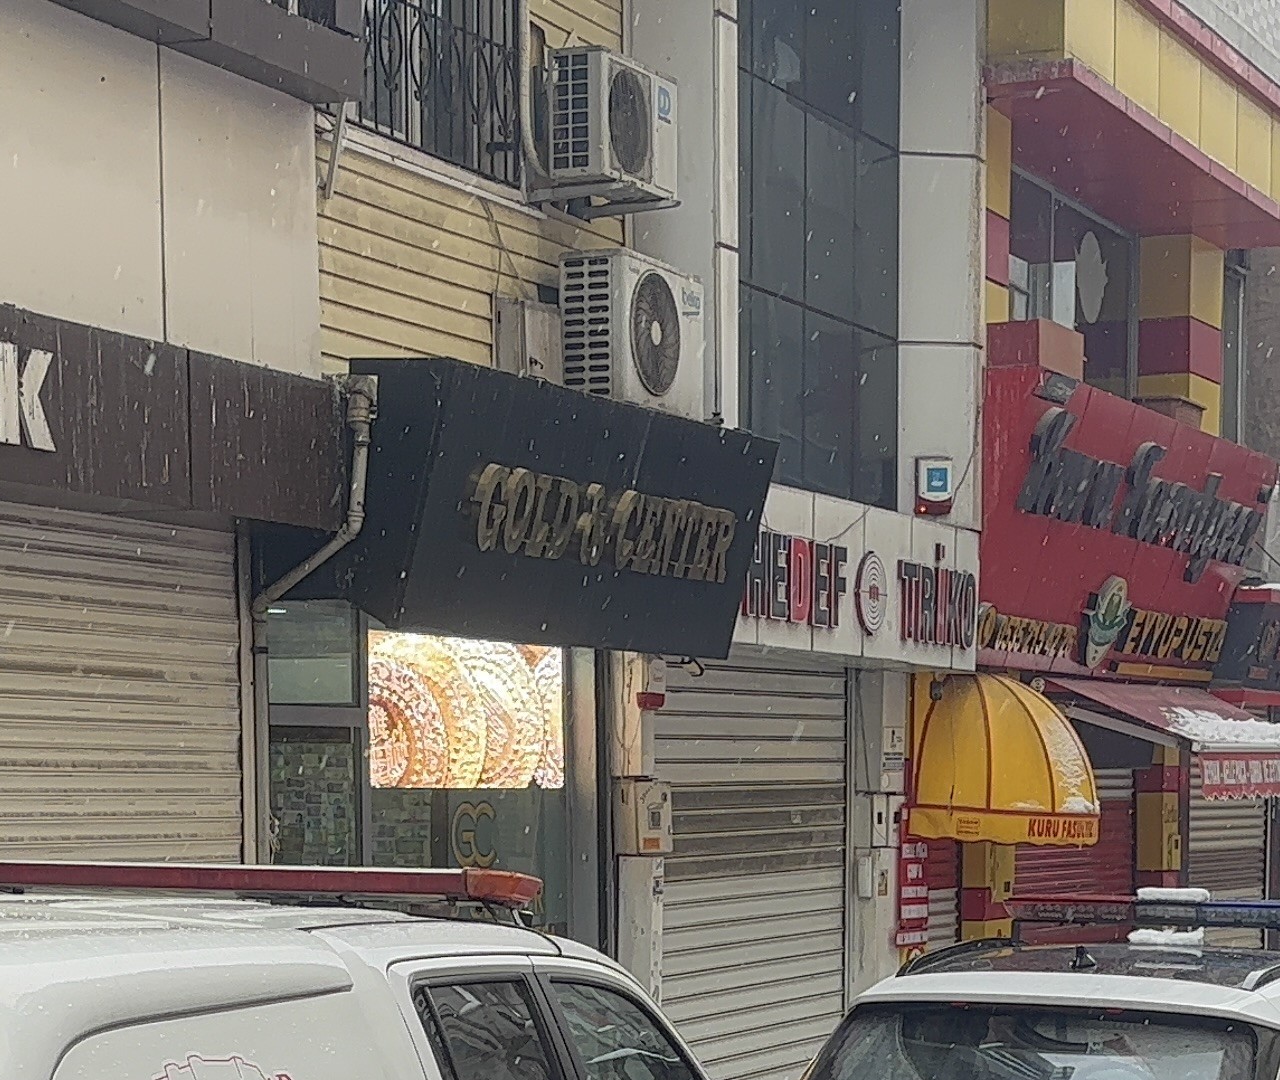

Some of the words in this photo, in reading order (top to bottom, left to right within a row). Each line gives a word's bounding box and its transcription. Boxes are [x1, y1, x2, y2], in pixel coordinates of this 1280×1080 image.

[472, 463, 578, 560] GOLD
[614, 489, 736, 584] CENTER
[742, 531, 847, 629] HEDEF
[1028, 818, 1060, 837] KURU
